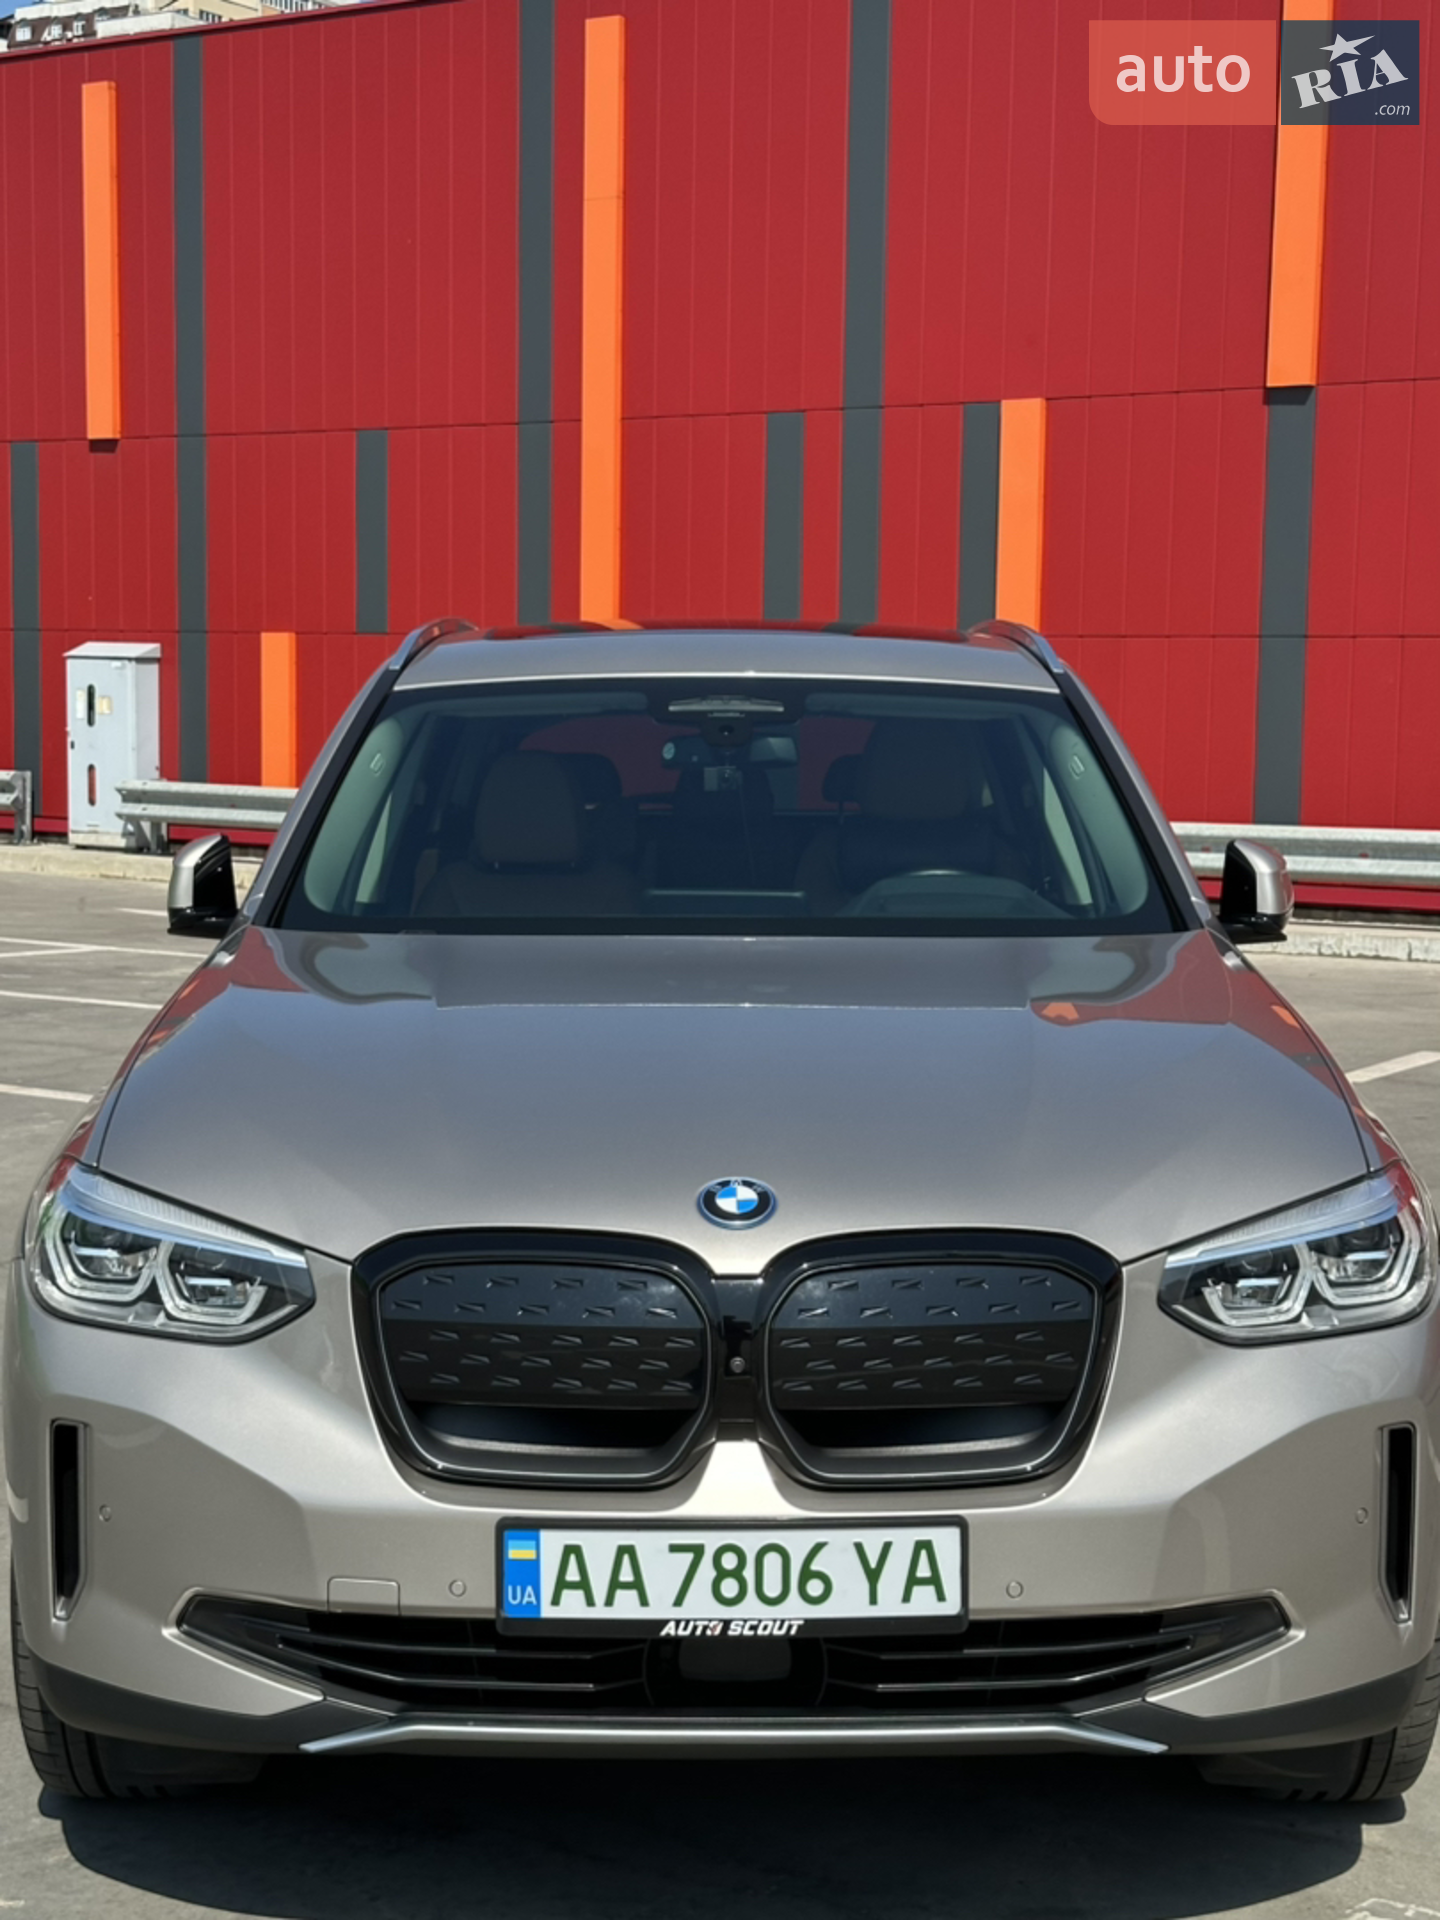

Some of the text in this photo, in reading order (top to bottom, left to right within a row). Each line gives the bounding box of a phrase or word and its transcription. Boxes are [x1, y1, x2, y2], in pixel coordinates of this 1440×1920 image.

[550, 1539, 947, 1607] AA 7806 YA
[507, 1586, 537, 1605] UA
[660, 1619, 804, 1637] AUTO SCOUT
